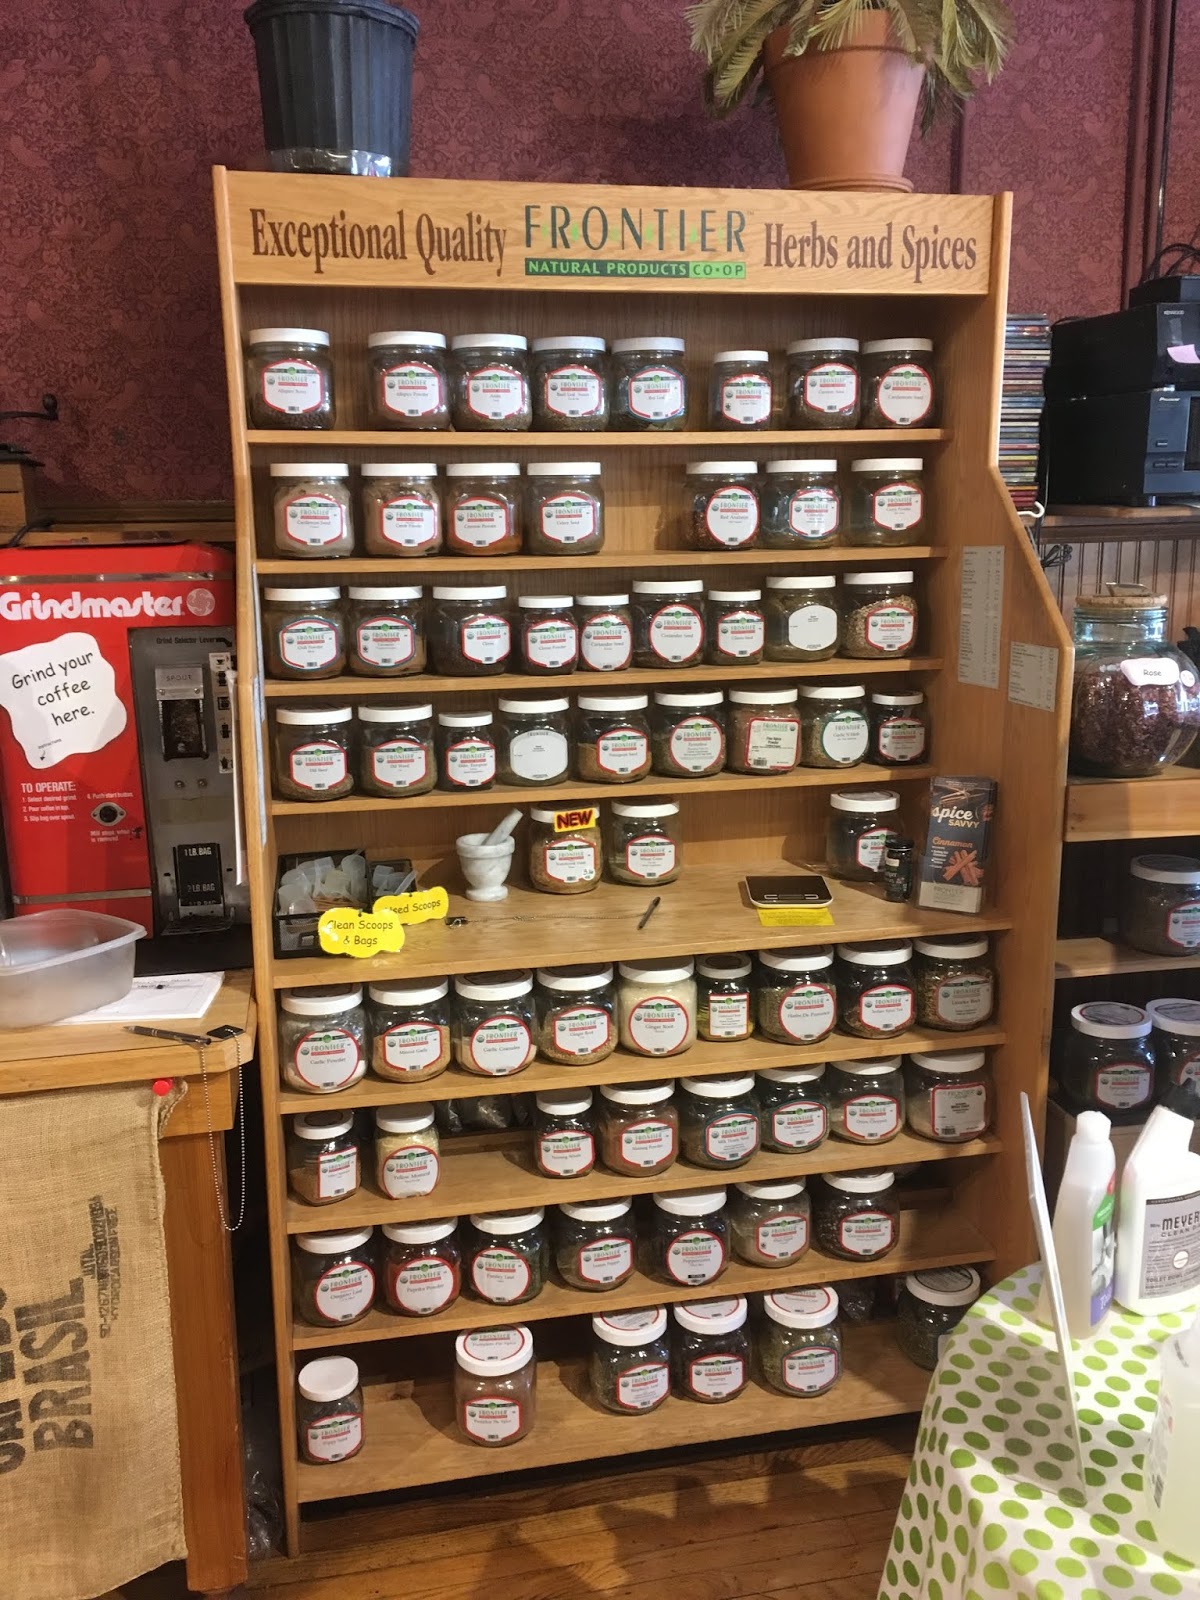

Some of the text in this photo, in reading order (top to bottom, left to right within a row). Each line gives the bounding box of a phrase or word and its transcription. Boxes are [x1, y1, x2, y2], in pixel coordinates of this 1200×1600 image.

[525, 205, 746, 252] FRONTIER
[250, 208, 507, 278] Exceptional Quality
[764, 220, 977, 284] Herbs and Spices
[528, 260, 600, 275] NATURAL
[606, 262, 687, 276] PRODUCTS
[0, 591, 183, 621] Grindmaster
[174, 636, 197, 645] Selector
[199, 636, 216, 644] Lever
[12, 652, 94, 689] Grind your
[1143, 669, 1162, 677] Rose
[166, 674, 193, 682] SPOUT
[38, 680, 91, 706] coffee
[51, 706, 95, 727] here.
[20, 780, 76, 794] TO OPERATE:
[557, 809, 593, 830] NEW
[932, 806, 974, 824] spice
[948, 819, 980, 829] SAVVY
[932, 838, 973, 850] Cinnamon
[198, 847, 212, 856] BAG
[202, 883, 216, 892] BAG
[412, 899, 441, 912] Scoops
[327, 920, 393, 931] Clean Scoops
[343, 935, 378, 948] & Bags
[310, 1043, 345, 1052] FRONTIER
[1161, 1227, 1190, 1239] CLEAN
[14, 1277, 93, 1452] BRASIL
